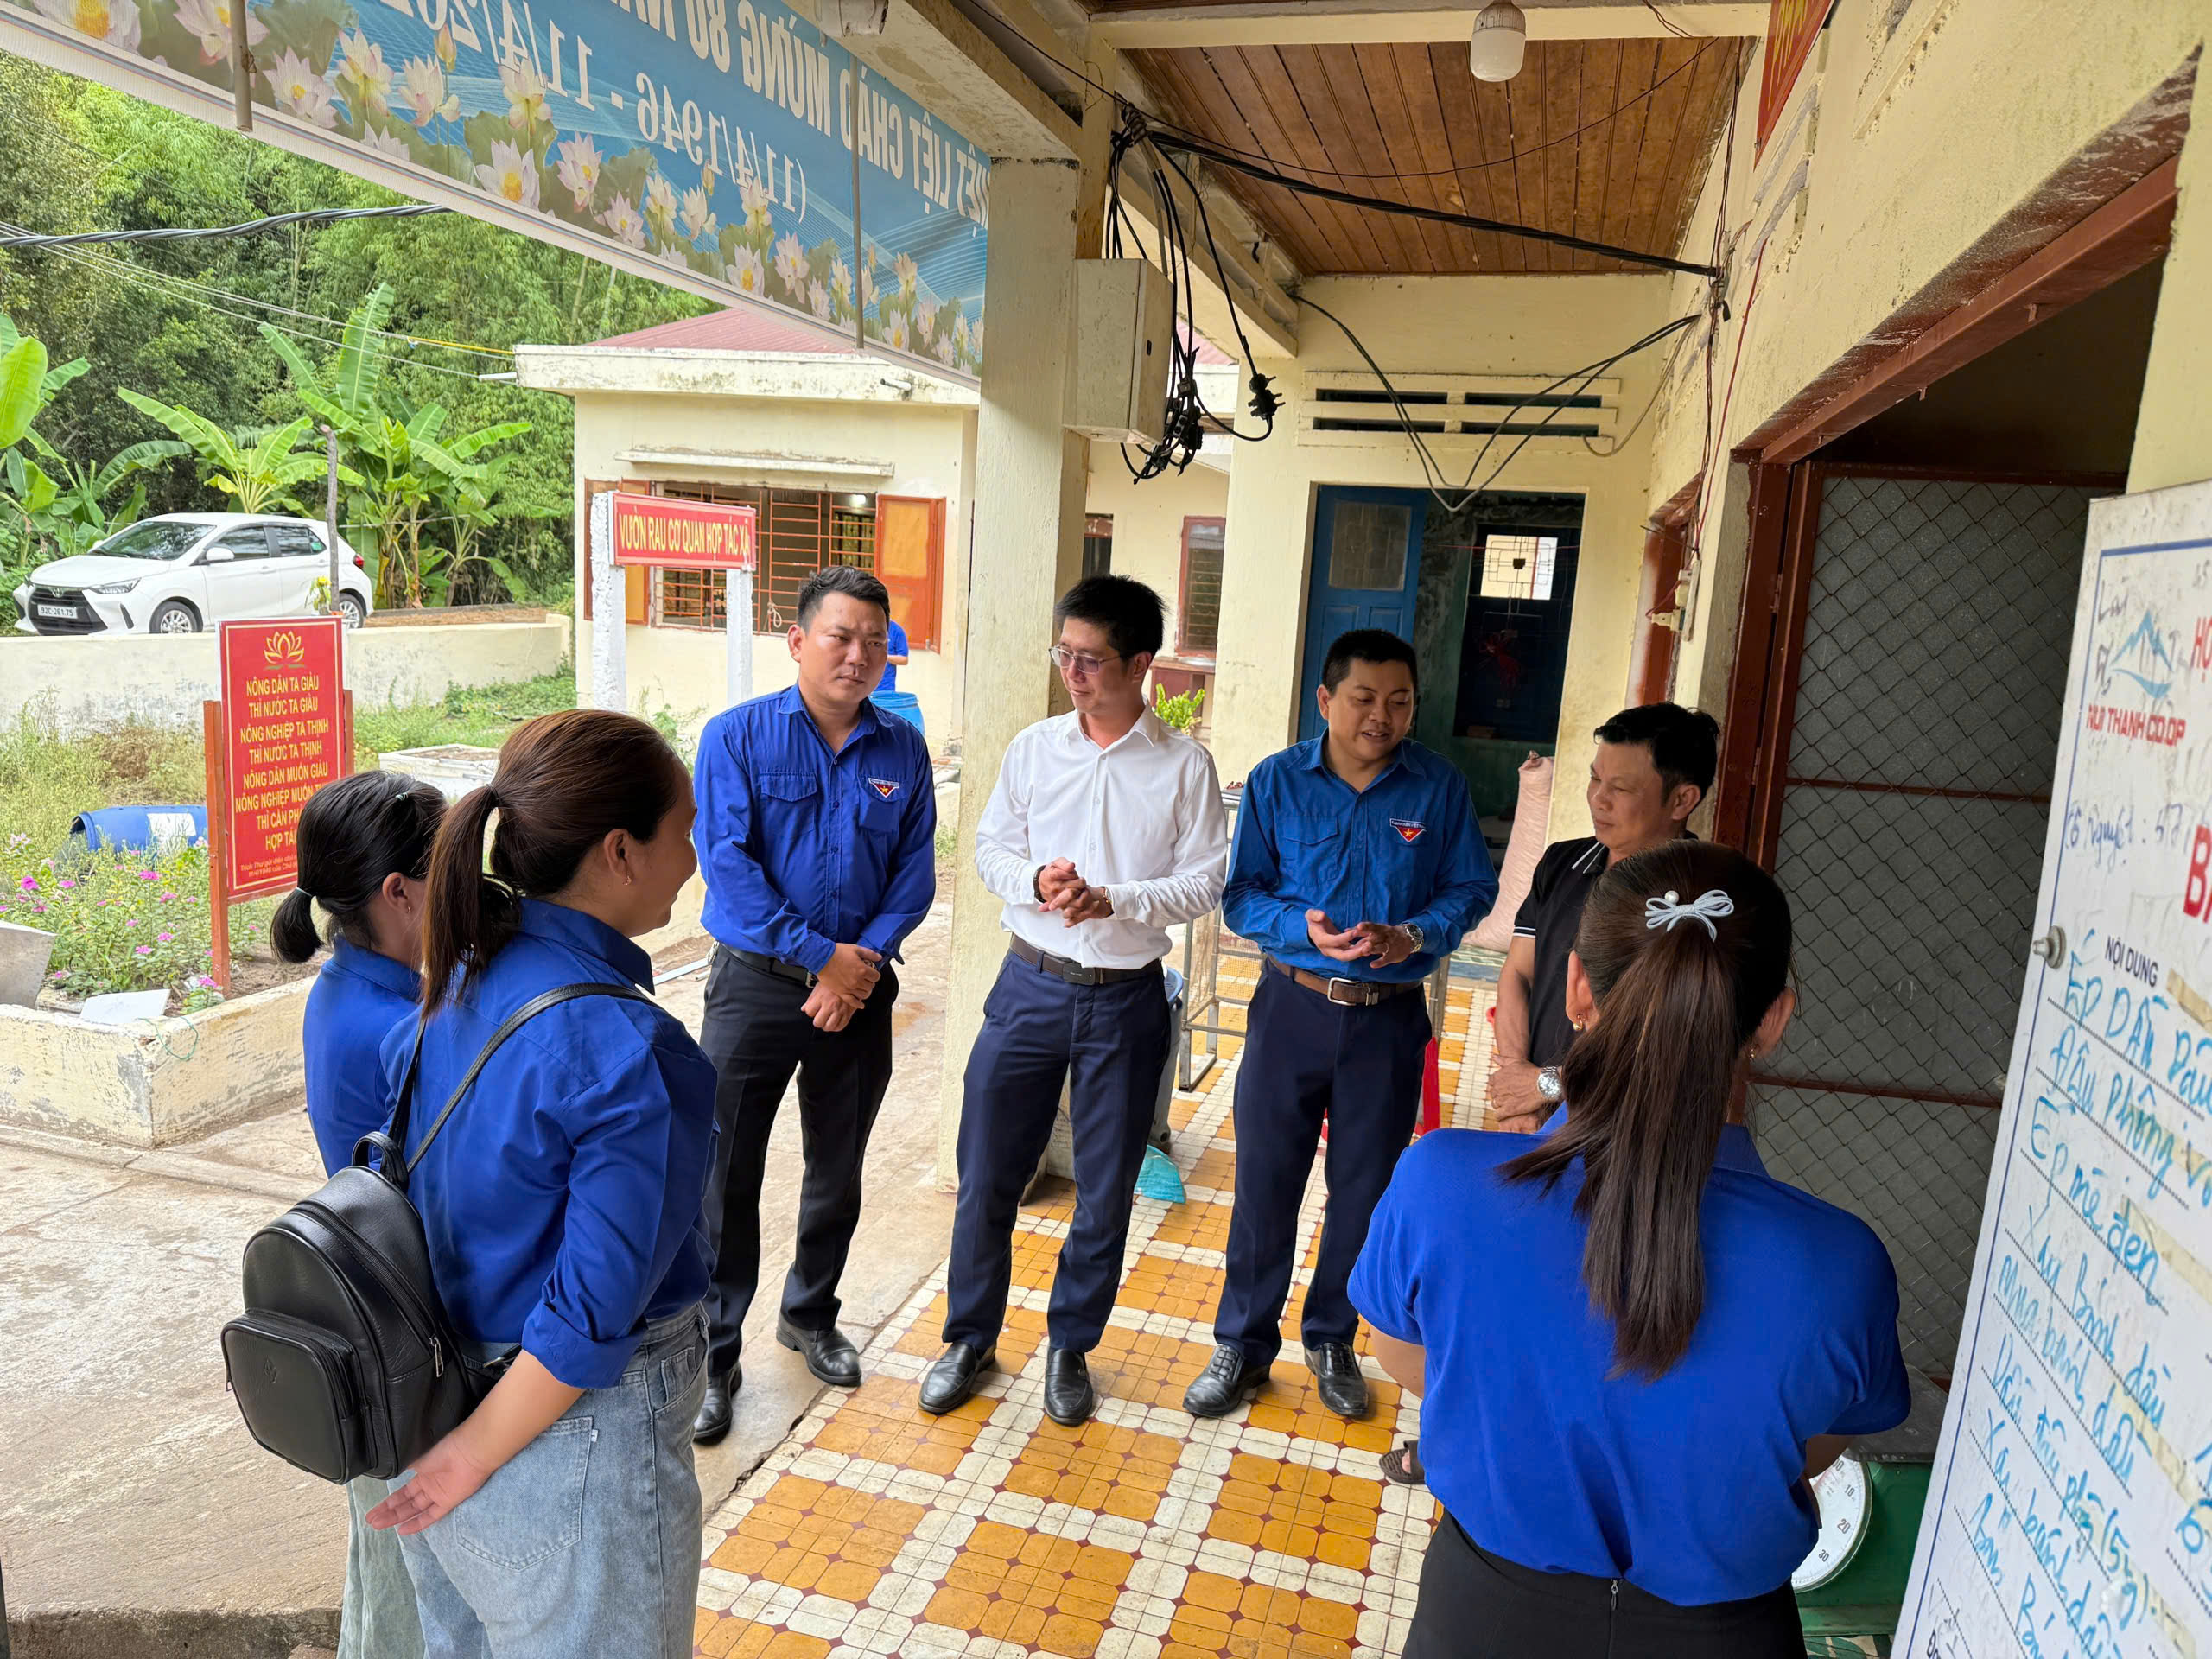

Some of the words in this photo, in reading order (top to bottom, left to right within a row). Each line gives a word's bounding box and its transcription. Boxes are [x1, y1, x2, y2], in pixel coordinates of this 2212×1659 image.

[619, 506, 646, 550] VƯỜN
[649, 517, 666, 551] RAU
[668, 518, 681, 552] CƠ
[683, 518, 705, 554] QUAN
[706, 522, 722, 562] HỢP
[724, 515, 739, 555] TÁC
[246, 676, 270, 696] NÔNG
[272, 674, 288, 694] DÂN
[289, 677, 300, 692] TA
[301, 672, 319, 691] GIÀU
[249, 698, 262, 719] THÌ
[264, 696, 288, 716] NƯỚC
[289, 699, 298, 713] TA
[300, 693, 318, 713] GIÀU
[240, 723, 264, 744] NÔNG
[265, 721, 294, 741] NGHIỆP
[296, 721, 306, 736] TA
[307, 718, 329, 738] THỊNH
[249, 744, 263, 765] THÌ
[264, 741, 288, 762] NƯỚC
[289, 744, 299, 759] TA
[300, 740, 322, 760] THỊNH
[243, 771, 267, 790] NÔNG
[268, 766, 285, 786] DÂN
[287, 762, 309, 782] MUỐN
[310, 759, 328, 779] GIÀU
[235, 795, 258, 813] NÔNG
[261, 788, 289, 809] NGHIỆP
[257, 810, 270, 830] THÌ
[270, 808, 287, 828] CẦN
[265, 832, 283, 853] HỢP
[2105, 935, 2125, 970] NỘI
[2125, 947, 2158, 987] DUNG
[1845, 1484, 1855, 1497] 10
[1836, 1518, 1851, 1535] 20
[1818, 1549, 1829, 1562] 30
